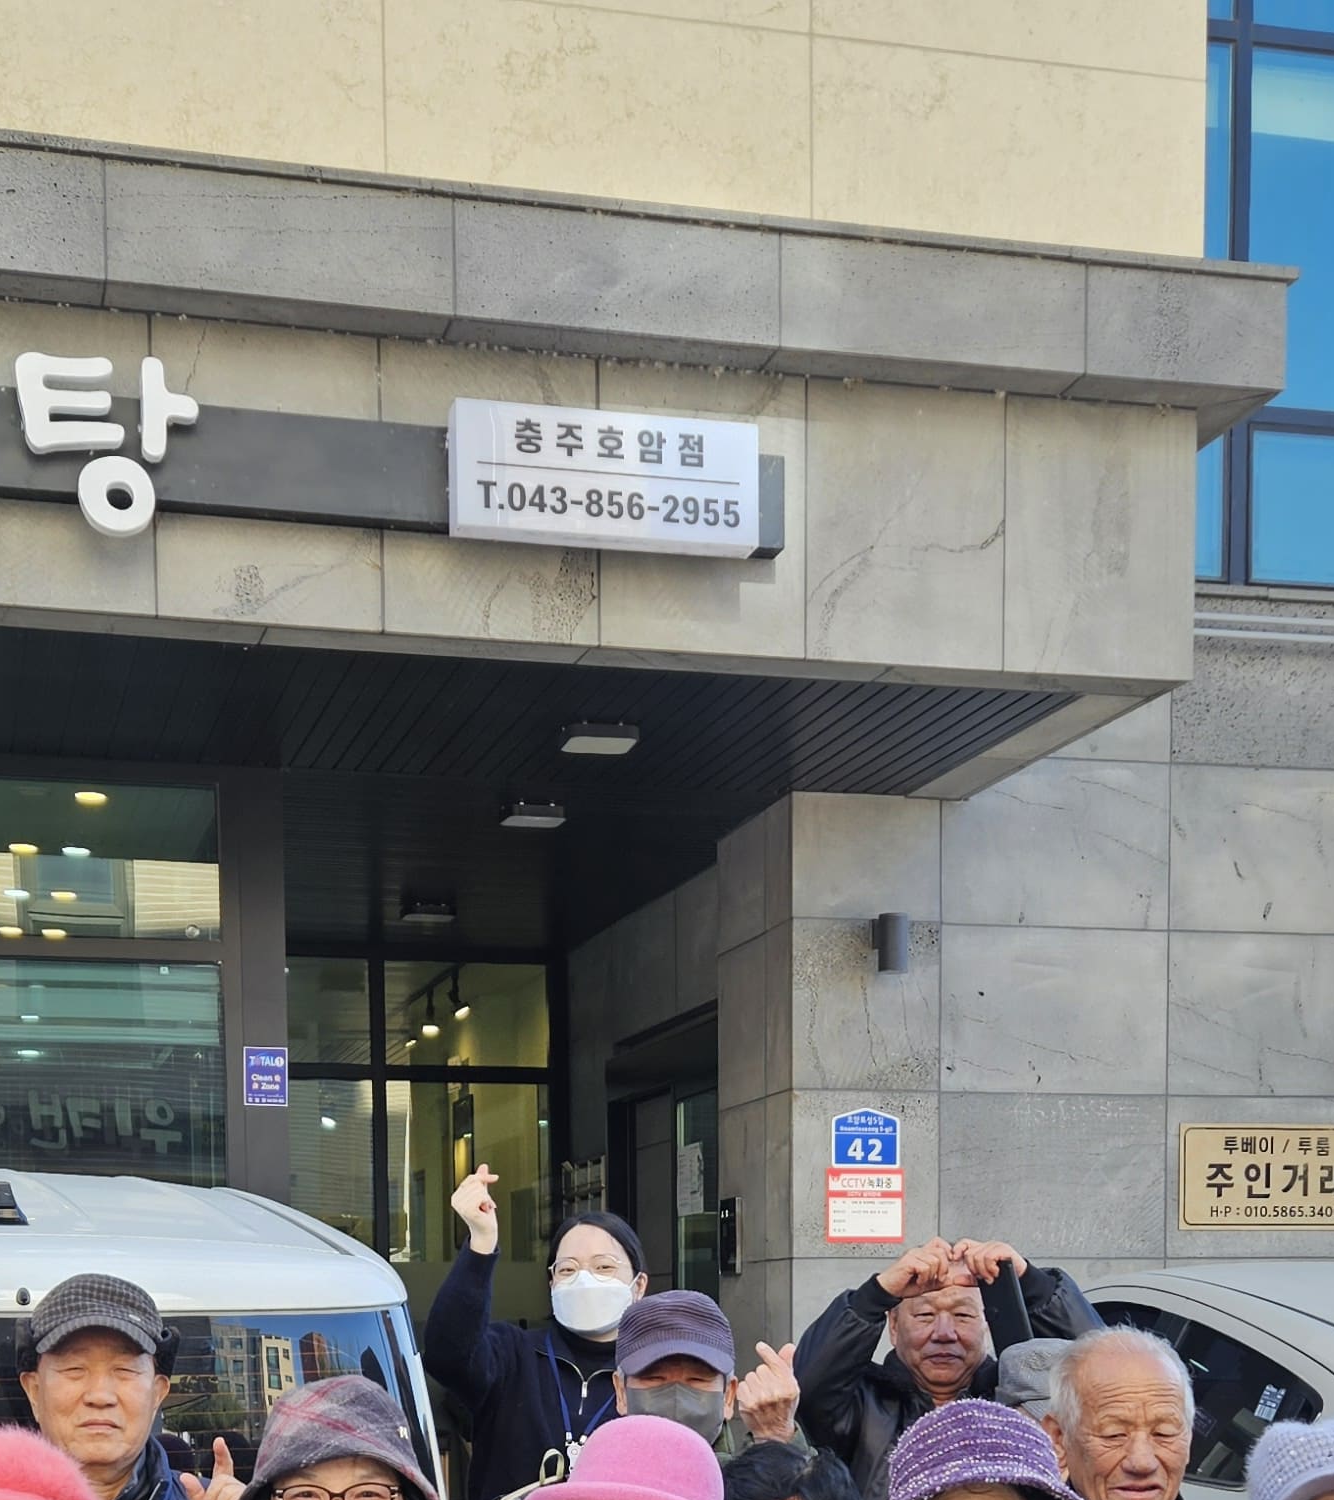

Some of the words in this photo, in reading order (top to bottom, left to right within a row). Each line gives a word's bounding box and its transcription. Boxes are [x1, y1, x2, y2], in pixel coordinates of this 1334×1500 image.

[513, 418, 705, 468] 충주호암점
[476, 479, 741, 529] T.043-856-2955
[847, 1138, 883, 1161] 42
[1223, 1136, 1274, 1155] 투베이
[1298, 1136, 1331, 1157] 투룸
